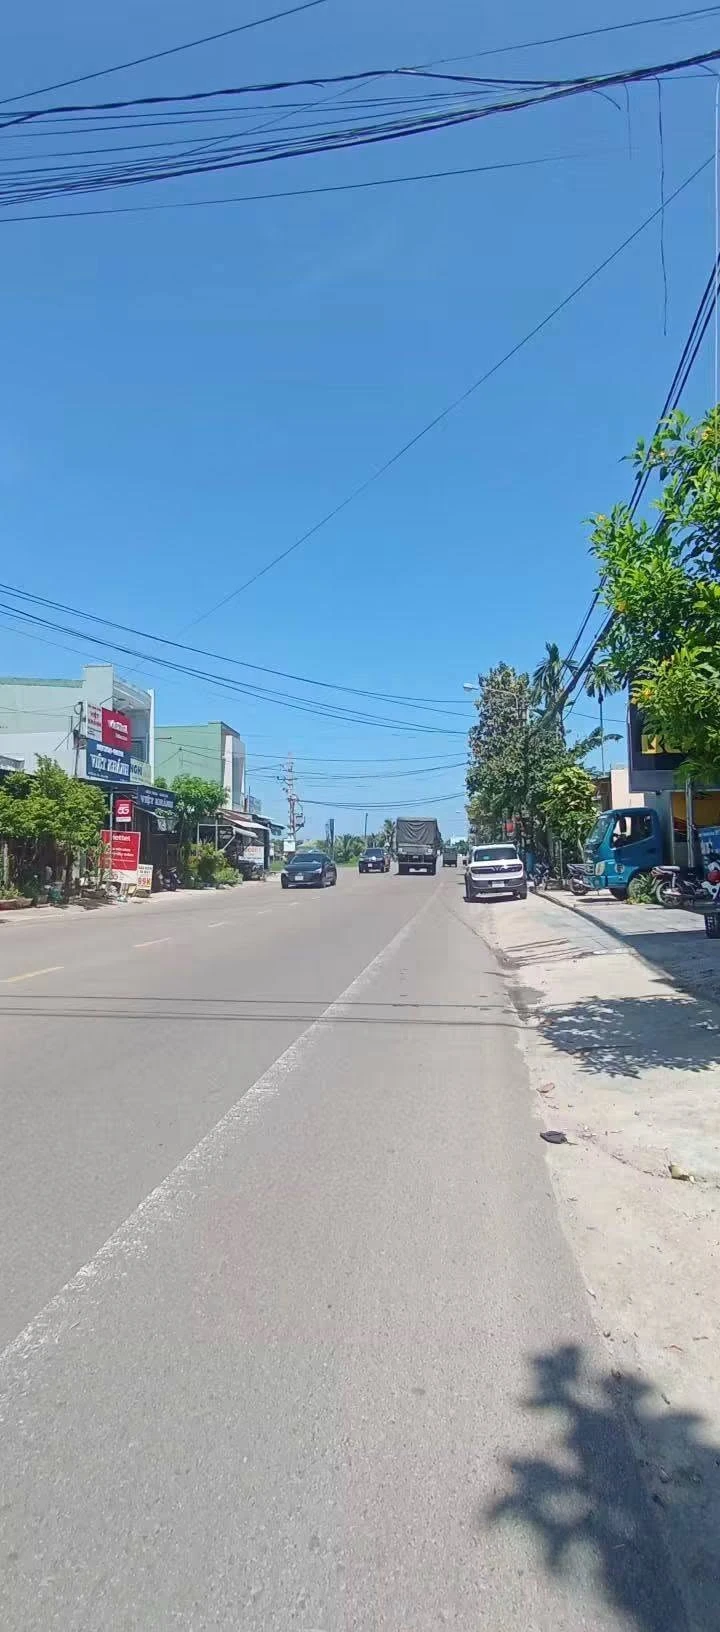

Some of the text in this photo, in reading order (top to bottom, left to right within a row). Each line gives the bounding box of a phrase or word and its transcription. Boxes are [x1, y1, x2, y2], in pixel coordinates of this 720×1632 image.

[90, 753, 107, 771] VIỆT
[140, 794, 174, 809] VIỆT KHÁNH
[111, 834, 131, 842] iettel
